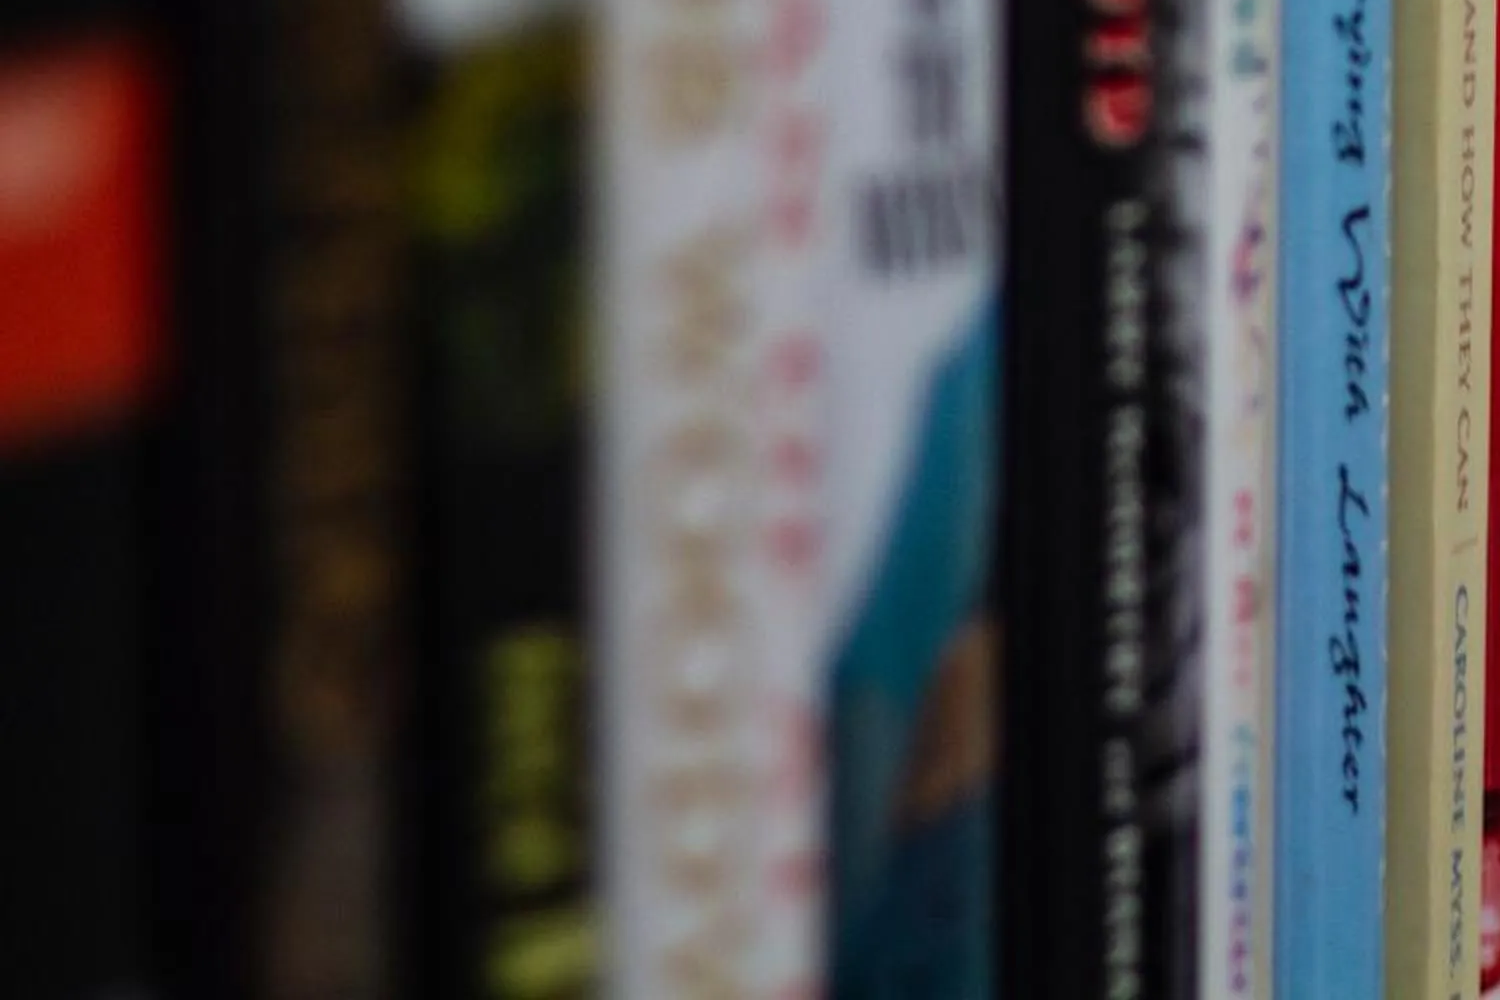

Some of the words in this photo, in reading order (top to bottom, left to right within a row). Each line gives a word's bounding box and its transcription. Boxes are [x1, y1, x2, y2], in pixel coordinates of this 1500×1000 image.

[1461, 0, 1477, 110] AND
[1459, 123, 1476, 249] HOW
[1335, 203, 1372, 422] With
[1456, 267, 1474, 392] THEY
[1454, 410, 1471, 513] CAN
[1328, 460, 1370, 816] Laughter
[1450, 584, 1470, 834] CAROLINE
